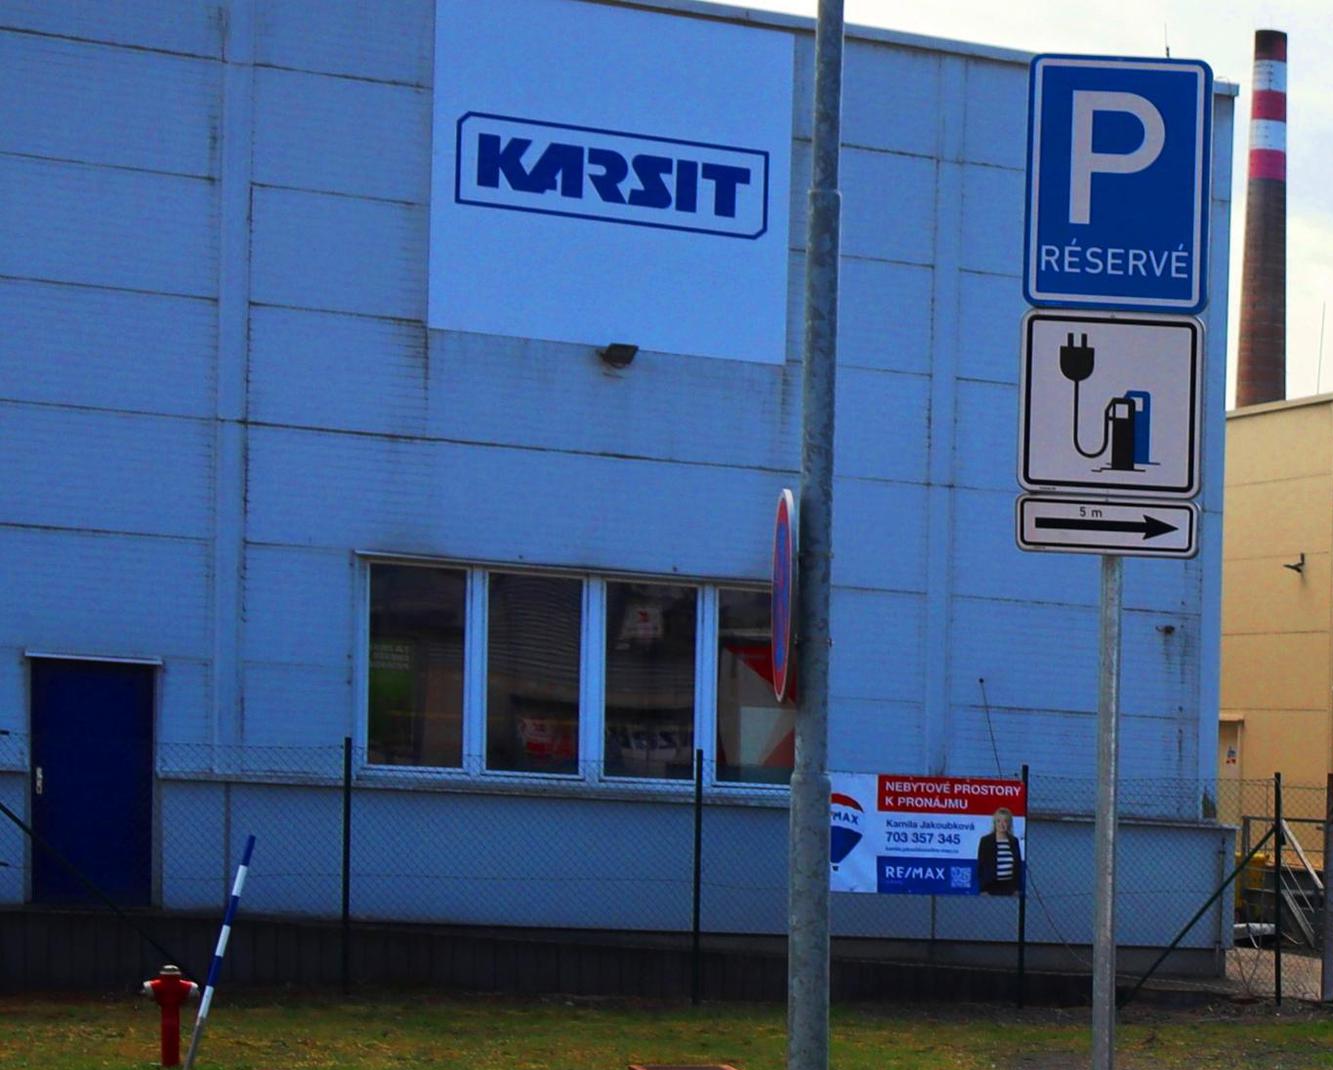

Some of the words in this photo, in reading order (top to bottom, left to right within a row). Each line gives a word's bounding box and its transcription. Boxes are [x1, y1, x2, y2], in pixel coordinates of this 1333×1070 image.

[1070, 90, 1166, 225] P
[475, 132, 751, 218] KARSIT
[1039, 242, 1190, 280] RÉSERVÉ
[1079, 506, 1086, 518] 5
[1091, 508, 1103, 518] m
[885, 780, 951, 794] NEBYTOVÉ
[953, 784, 1022, 797] PROSTORY
[885, 796, 894, 807] K
[897, 796, 968, 810] PRONÁJMU
[886, 819, 918, 830] Kamila
[886, 832, 909, 844] 703
[911, 832, 935, 845] 357
[938, 833, 961, 845] 345
[885, 866, 946, 880] RE/MAX
